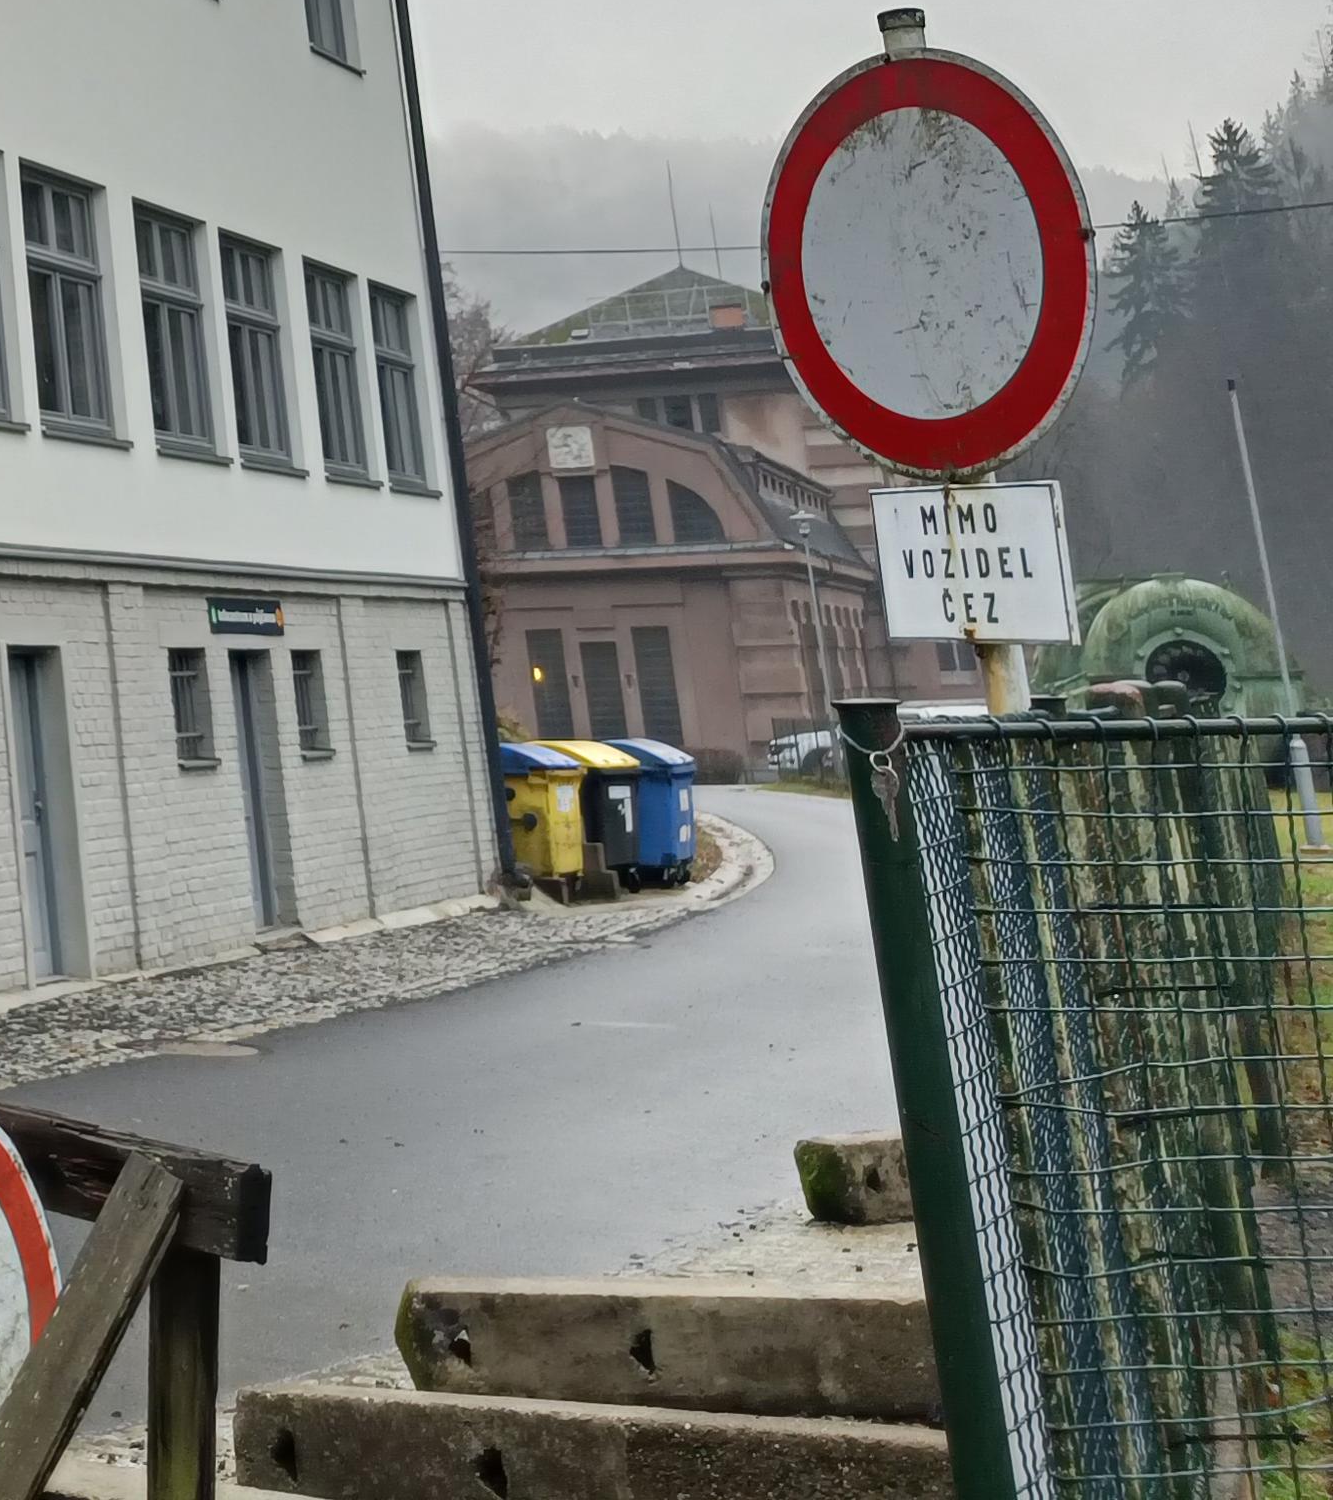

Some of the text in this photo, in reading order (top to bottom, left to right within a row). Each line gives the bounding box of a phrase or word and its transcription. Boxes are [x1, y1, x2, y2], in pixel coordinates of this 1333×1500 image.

[920, 503, 997, 535] MIMO
[902, 547, 1033, 578] VOZIDEL
[942, 588, 999, 623] ČEZ
